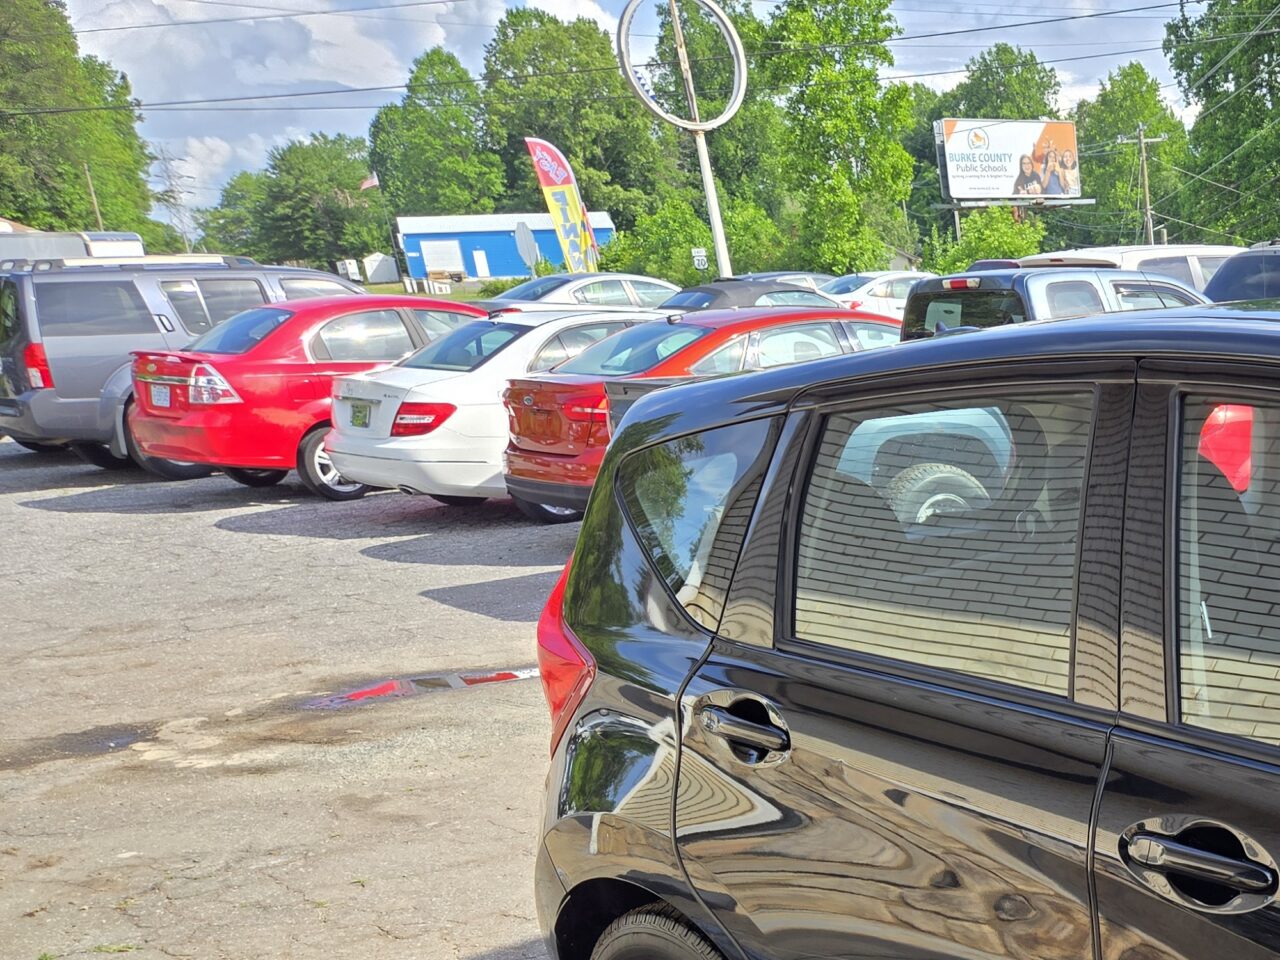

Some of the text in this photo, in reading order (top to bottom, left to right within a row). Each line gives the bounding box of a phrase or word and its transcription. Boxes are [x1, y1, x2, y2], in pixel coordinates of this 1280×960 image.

[949, 152, 1013, 163] BURKE COUNTY
[956, 163, 1008, 173] Public Schools
[695, 258, 707, 267] 70
